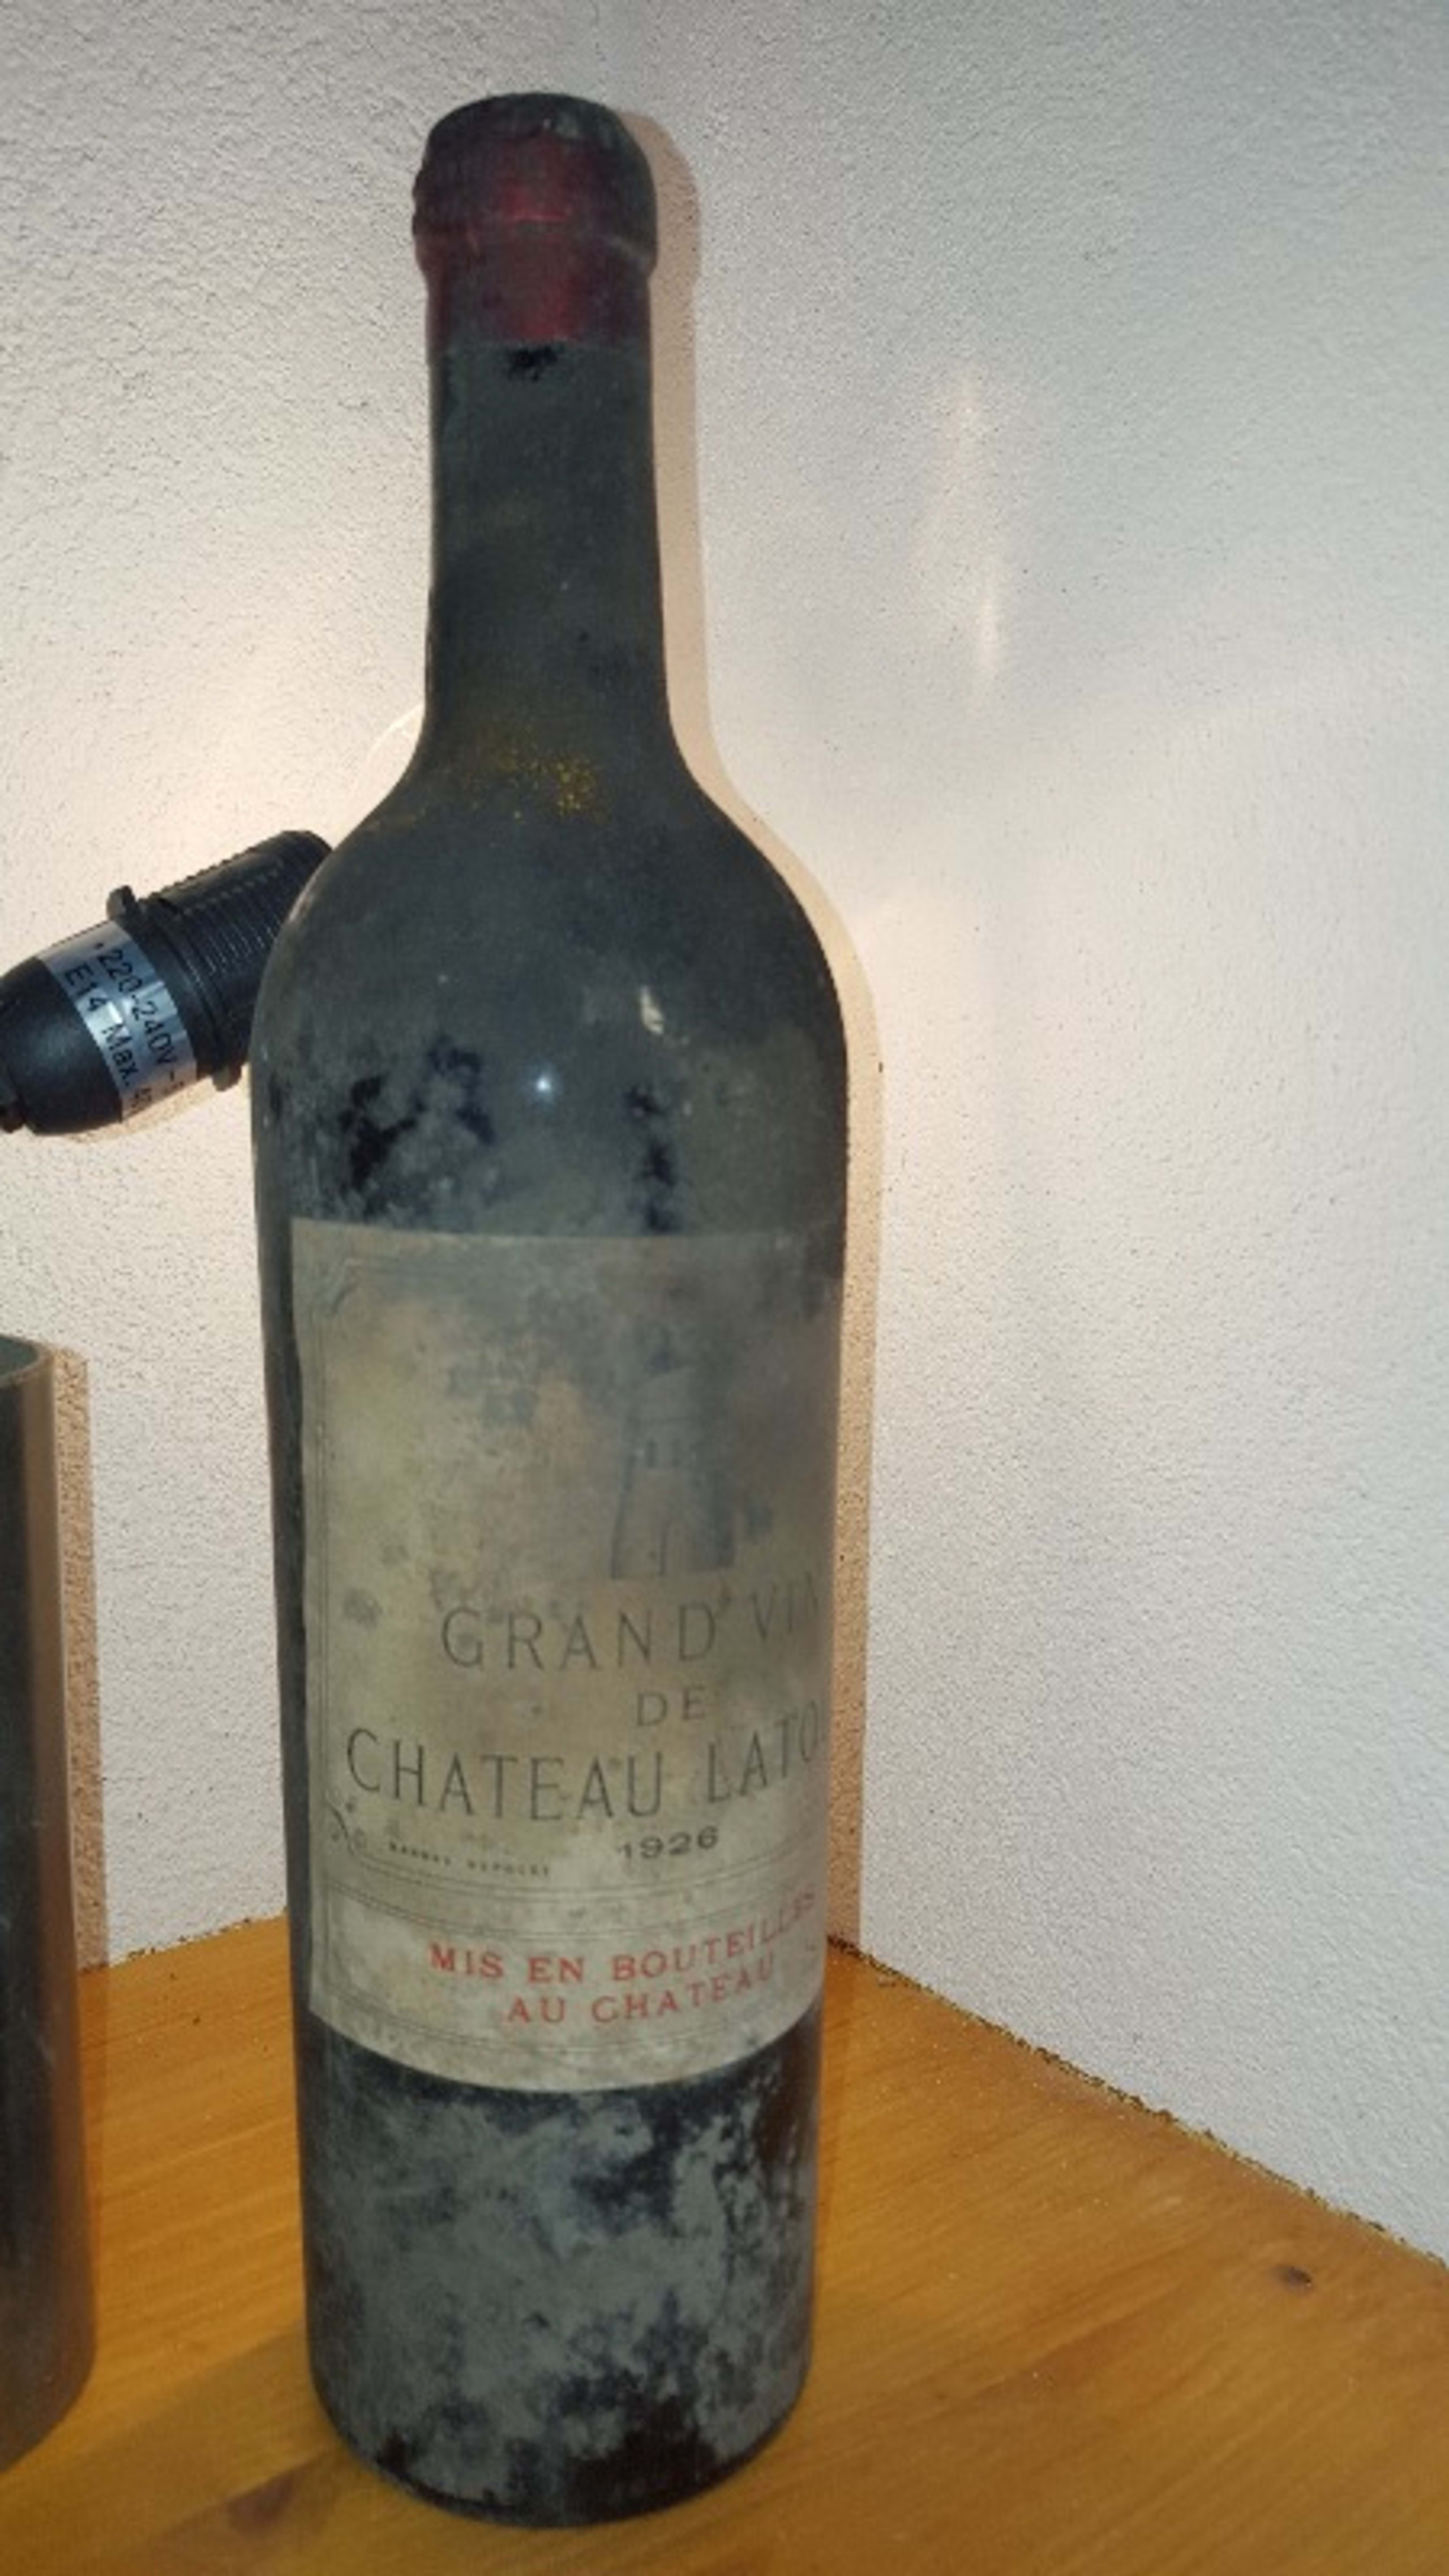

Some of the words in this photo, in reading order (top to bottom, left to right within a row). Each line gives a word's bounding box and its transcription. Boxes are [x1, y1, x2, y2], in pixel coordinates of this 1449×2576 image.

[63, 963, 106, 1012] E14
[441, 1602, 715, 1671] GRAND
[636, 1685, 705, 1728] DE
[346, 1726, 663, 1821] CHATEAU
[617, 1825, 718, 1861] 1926
[428, 1943, 504, 1979] MIS
[528, 1956, 585, 1984] EN
[507, 1998, 565, 2025] AU
[592, 1951, 774, 2024] CHATEAU
